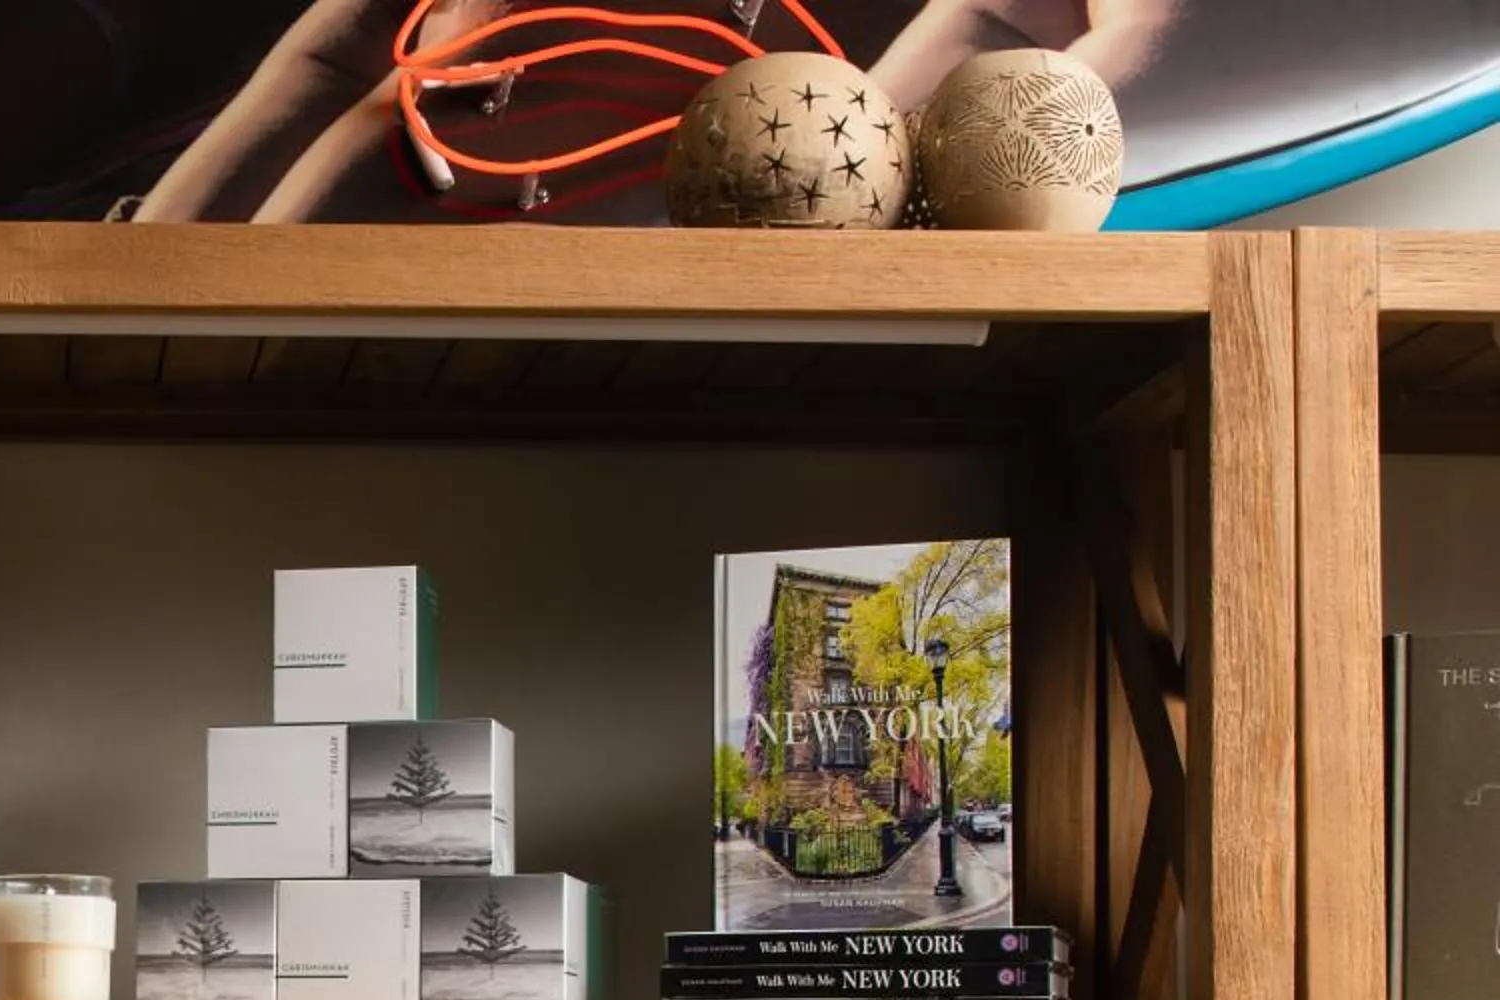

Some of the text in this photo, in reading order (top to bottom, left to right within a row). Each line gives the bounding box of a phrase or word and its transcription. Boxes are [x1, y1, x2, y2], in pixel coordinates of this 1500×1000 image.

[1438, 669, 1485, 686] THE
[806, 685, 920, 704] Walk With Me
[753, 700, 977, 747] NEW YORK
[759, 941, 786, 953] Walk
[789, 941, 817, 953] With
[820, 940, 839, 953] Me
[845, 936, 897, 955] NEW
[902, 934, 964, 954] YORK
[756, 975, 784, 987] Walk
[787, 975, 815, 987] With
[818, 974, 836, 986] Me
[842, 970, 894, 989] NEW
[899, 968, 961, 988] YORK
